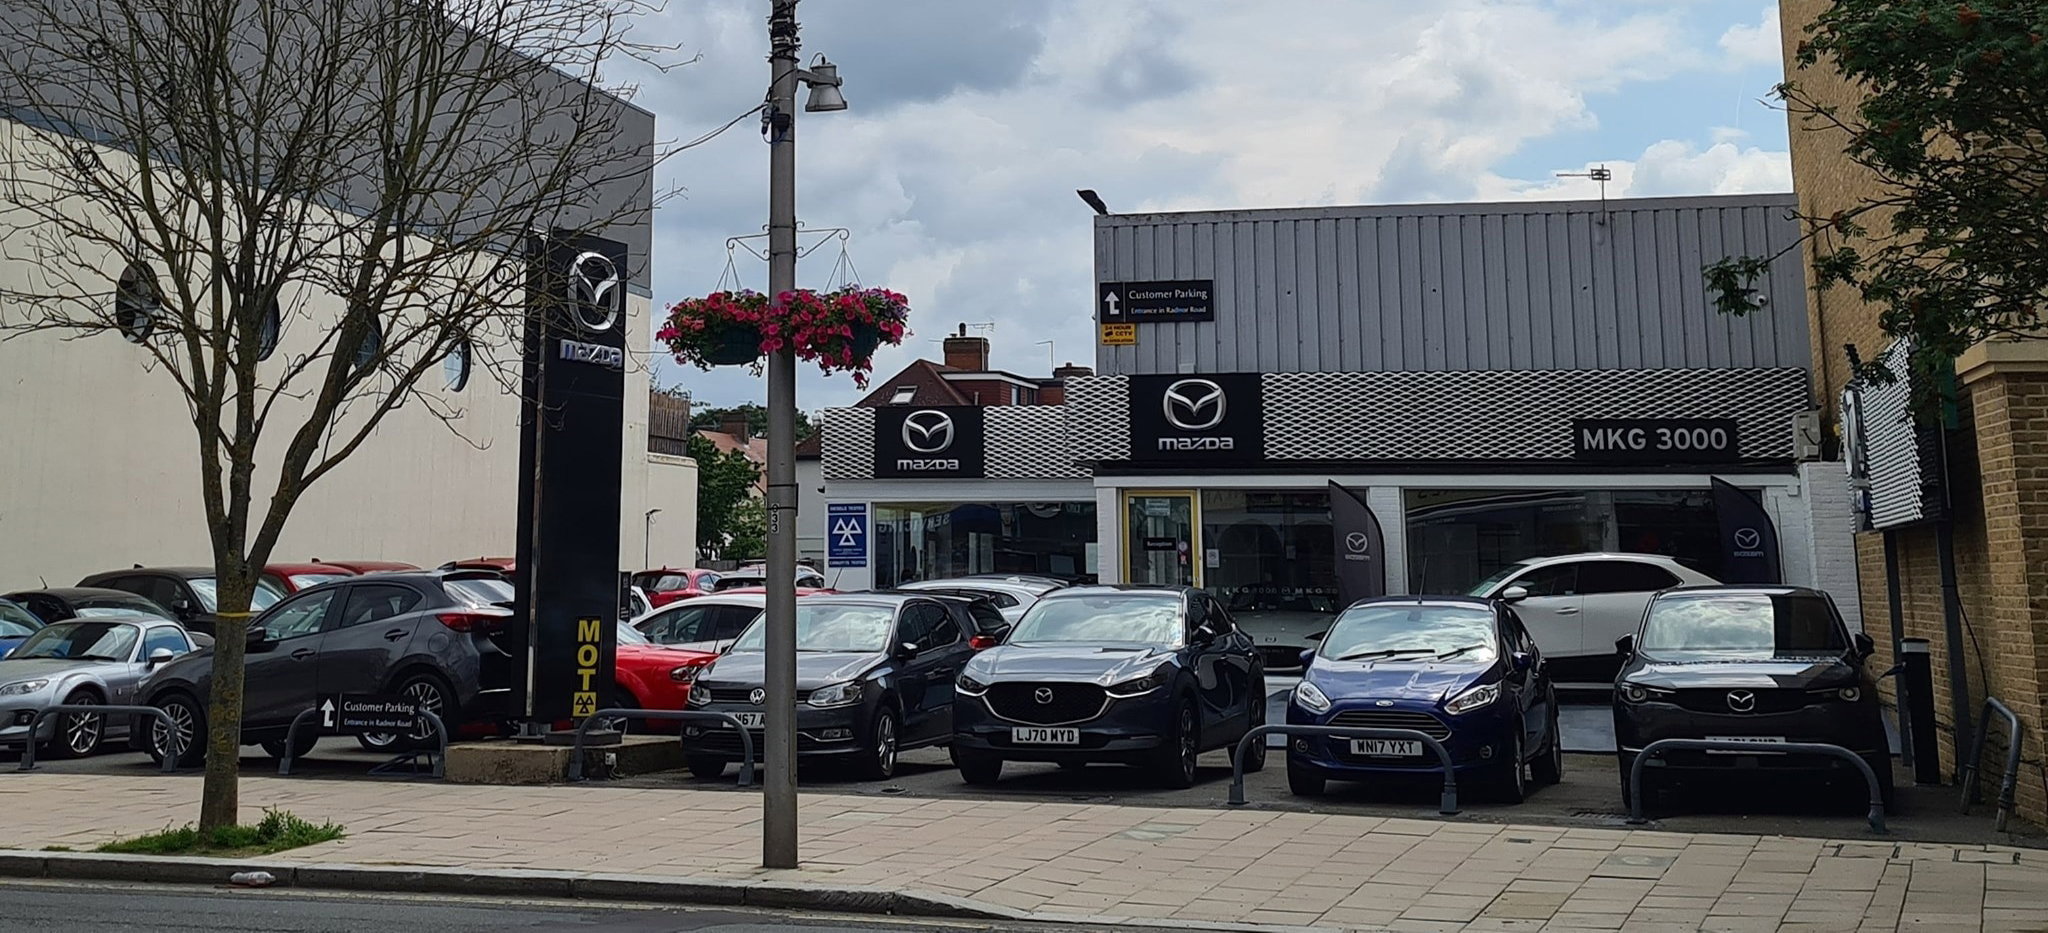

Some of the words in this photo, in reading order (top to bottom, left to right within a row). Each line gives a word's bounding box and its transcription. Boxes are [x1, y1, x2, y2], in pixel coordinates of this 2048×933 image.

[1129, 291, 1172, 300] Customer
[1174, 289, 1208, 300] Parking
[560, 339, 622, 367] mazda
[1158, 437, 1234, 450] mazda
[1583, 428, 1646, 450] MKG
[1656, 428, 1727, 450] 3000
[897, 459, 959, 470] mazda
[578, 620, 600, 690] MOT
[344, 701, 383, 712] Customer
[385, 702, 414, 716] Parking
[1016, 729, 1048, 741] LJ70
[1051, 730, 1074, 742] MYD
[1357, 740, 1385, 753] WN17
[1390, 741, 1413, 753] YXT
